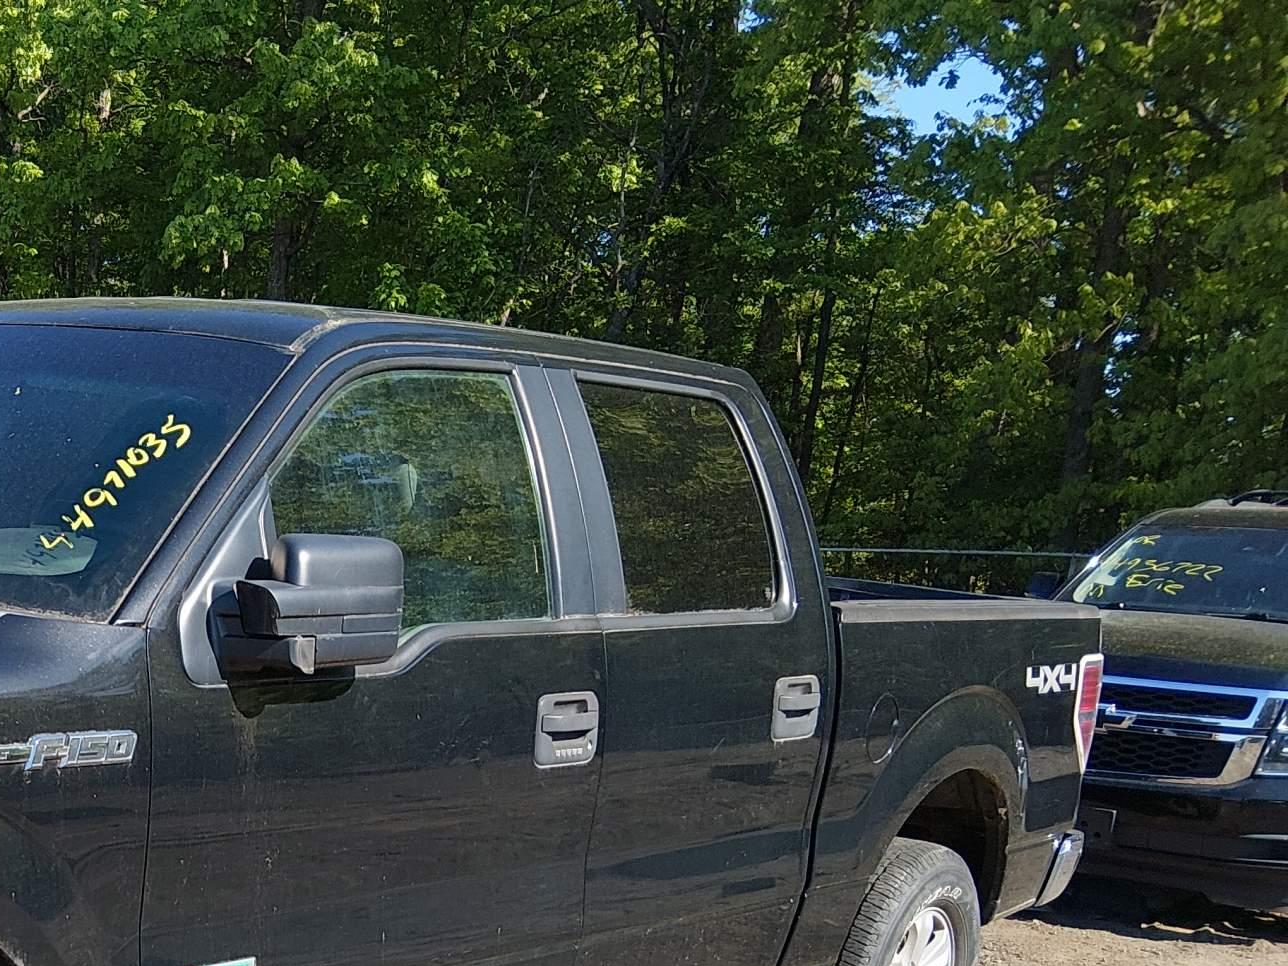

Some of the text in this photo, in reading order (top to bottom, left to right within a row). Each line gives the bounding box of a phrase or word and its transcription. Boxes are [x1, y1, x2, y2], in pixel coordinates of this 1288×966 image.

[39, 413, 192, 549] 44971035
[1125, 574, 1185, 596] Erie
[24, 729, 139, 771] F-150
